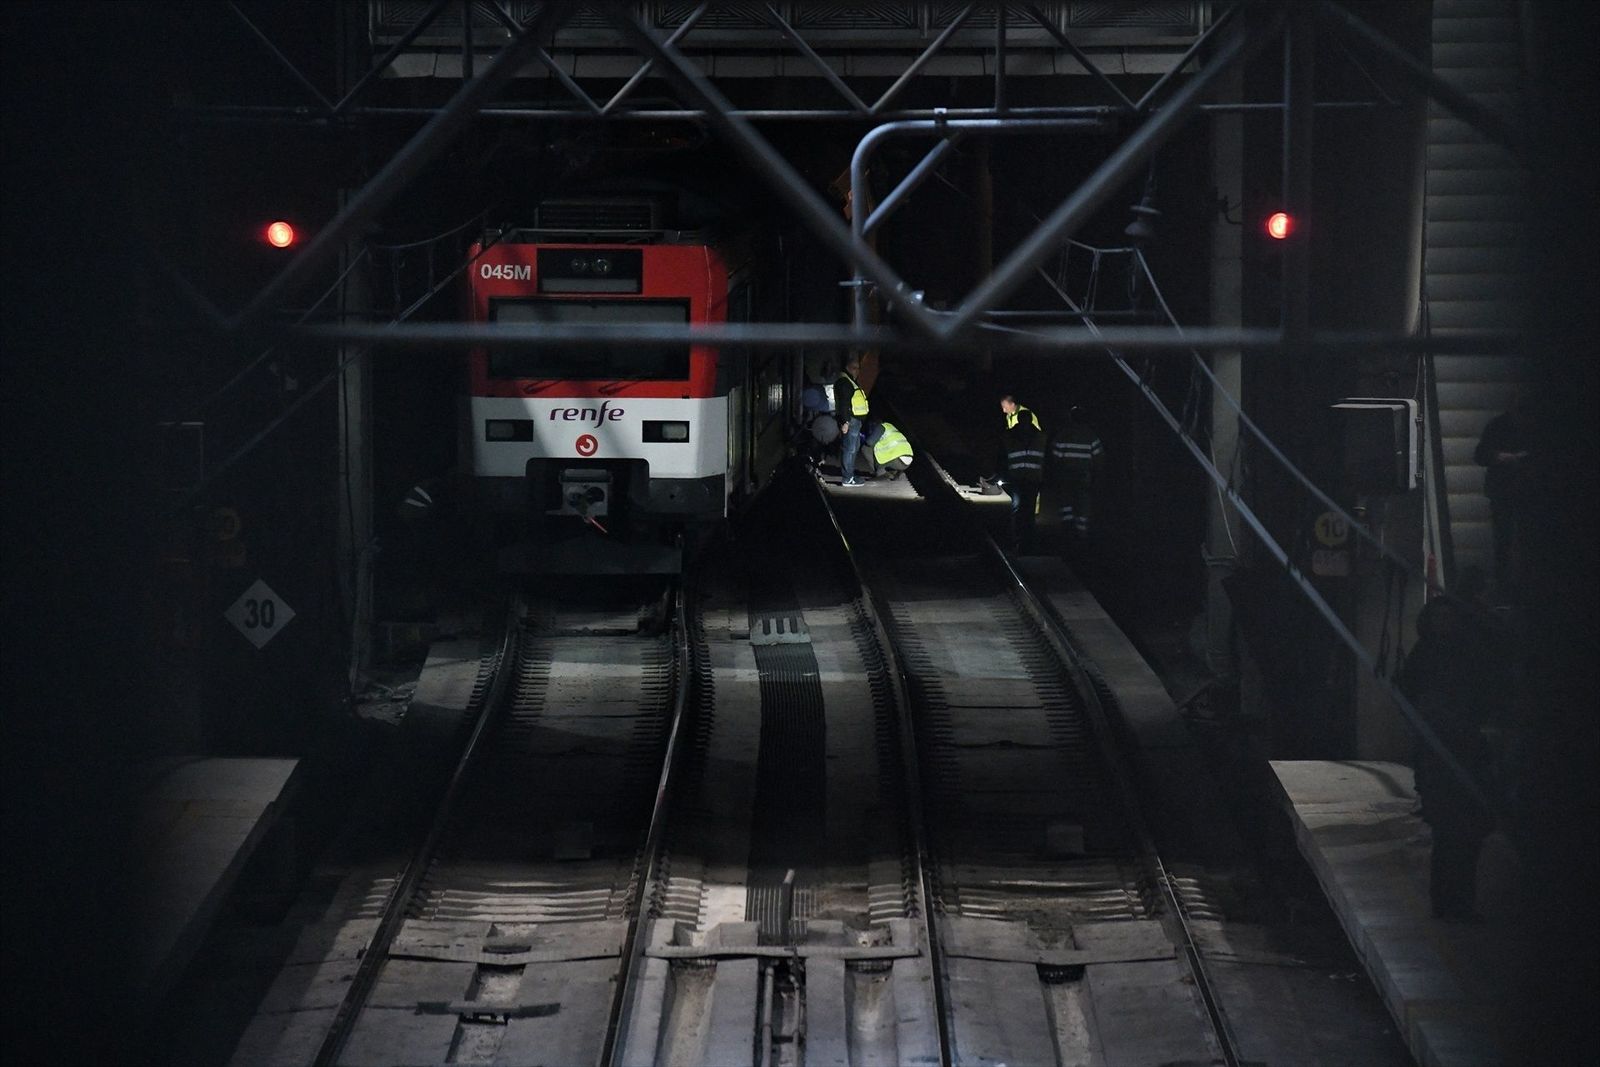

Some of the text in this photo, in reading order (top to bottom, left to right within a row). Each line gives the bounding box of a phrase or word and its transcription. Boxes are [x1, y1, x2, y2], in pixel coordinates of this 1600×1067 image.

[480, 263, 532, 281] 045M
[549, 400, 625, 429] renfe
[244, 598, 276, 630] 30
